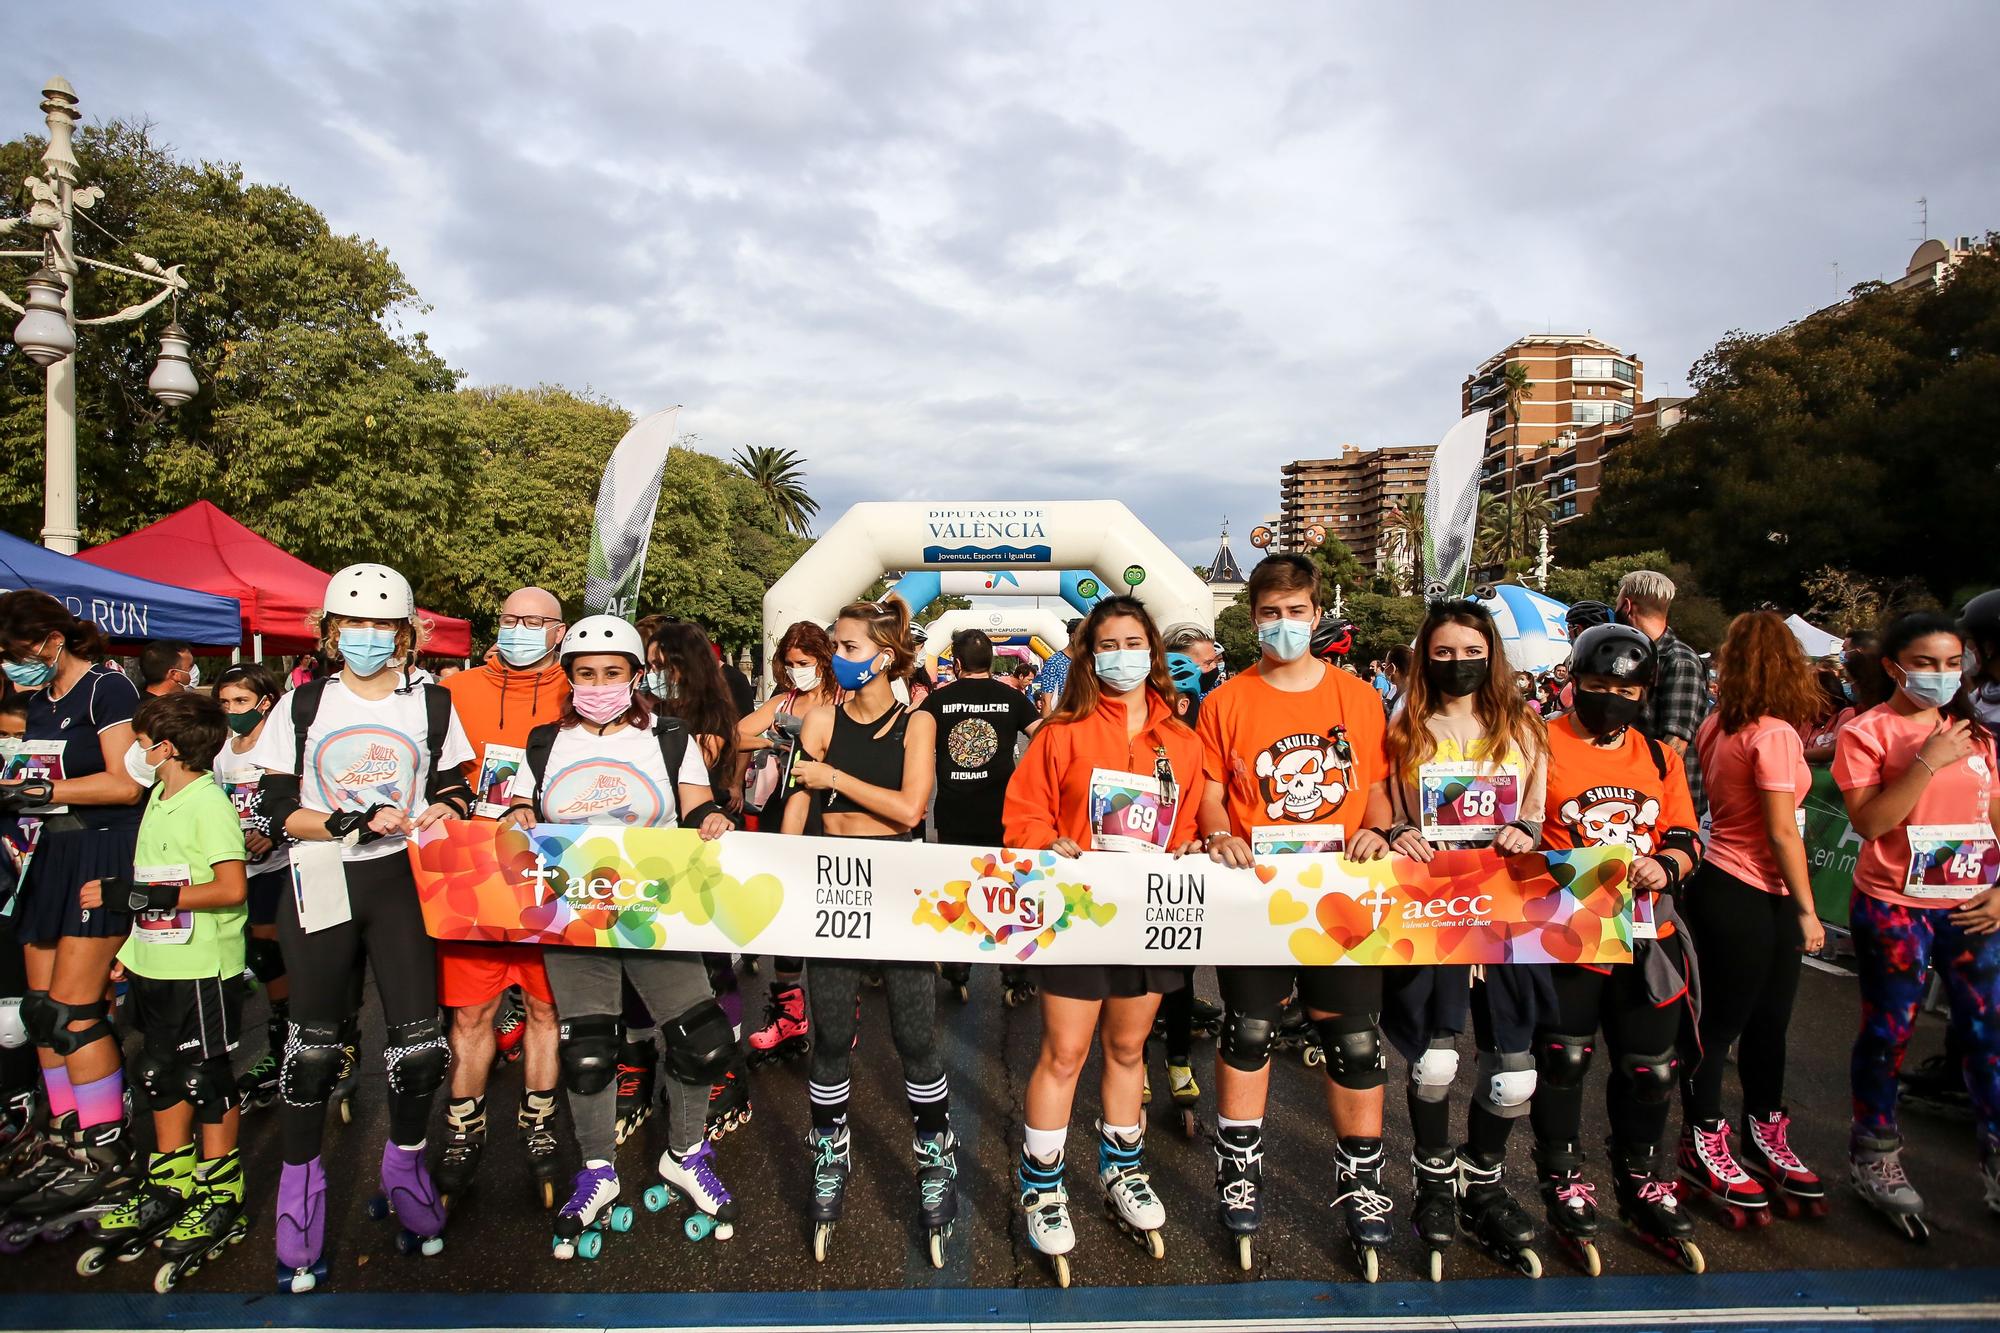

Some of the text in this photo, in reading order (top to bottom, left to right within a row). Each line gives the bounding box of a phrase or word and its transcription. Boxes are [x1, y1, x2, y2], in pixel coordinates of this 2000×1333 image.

[1024, 510, 1044, 518] DE
[928, 520, 1046, 538] VALÈNCIA
[973, 552, 1002, 561] Esports
[1008, 552, 1036, 560] Igualtat
[91, 599, 148, 636] RUN
[942, 703, 1010, 714] HIPPYROLLERS
[1276, 734, 1320, 753] SKULLS
[354, 760, 397, 773] DISCO
[950, 770, 988, 780] RICHARD
[335, 770, 397, 785] PARTY
[582, 786, 626, 801] DISCO
[1585, 787, 1636, 802] SKULLS
[557, 795, 628, 814] PARTY
[1463, 790, 1497, 818] 58
[1126, 803, 1158, 833] 69
[817, 854, 872, 888] RUN
[1949, 853, 1984, 880] 45
[565, 876, 659, 900] aecc
[816, 885, 873, 906] CÁNCER
[1147, 873, 1205, 905] RUN
[596, 902, 621, 911] Contra
[624, 903, 631, 911] el
[982, 886, 1016, 914] YO
[1402, 894, 1493, 920] aecc
[1145, 904, 1205, 922] CÁNCER
[1431, 919, 1456, 928] Contra
[1457, 918, 1465, 927] el
[1466, 915, 1493, 927] Cáncer
[815, 909, 871, 939] 2021
[1144, 926, 1203, 950] 2021
